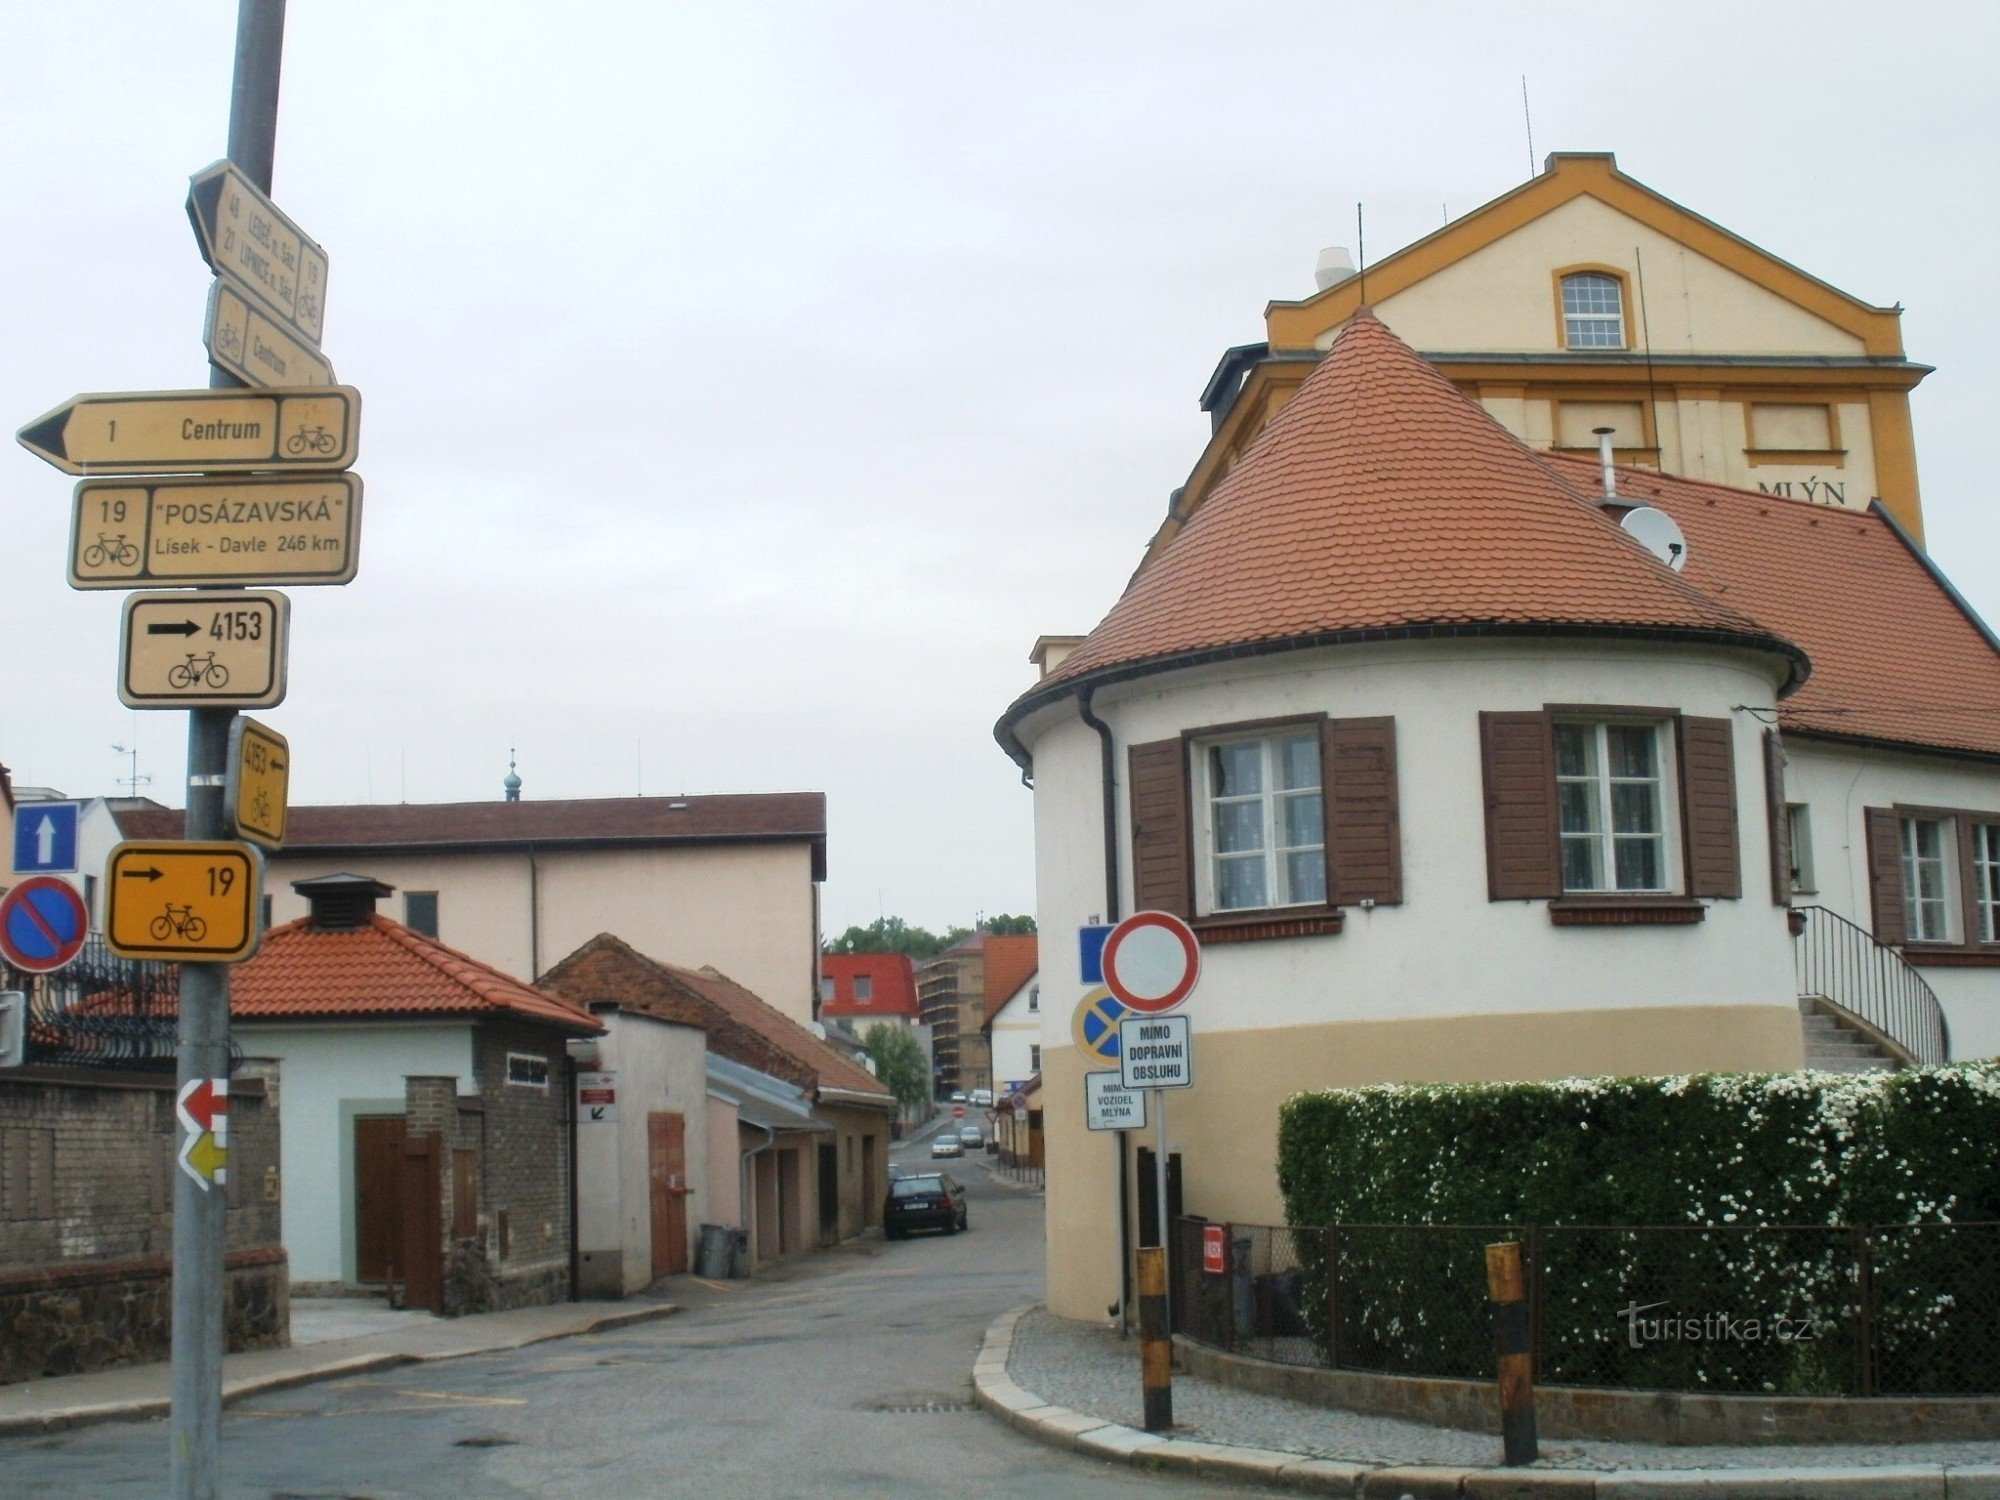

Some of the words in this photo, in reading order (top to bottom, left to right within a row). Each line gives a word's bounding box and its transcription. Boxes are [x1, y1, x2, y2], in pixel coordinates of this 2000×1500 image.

[309, 260, 319, 284] 19
[254, 335, 287, 377] Centrum
[107, 420, 116, 442] 1
[181, 418, 261, 441] Centrum
[100, 501, 127, 523] 19
[156, 495, 343, 525] "POSÁZAVSKÁ"
[155, 536, 200, 555] Lísek
[220, 536, 266, 553] Davle
[277, 535, 306, 552] 246
[312, 535, 340, 552] km
[209, 611, 262, 641] 4153
[243, 738, 267, 776] 4153
[207, 866, 235, 897] 19
[1139, 1025, 1170, 1040] MIMO
[1129, 1041, 1183, 1060] DOPRAVNÍ
[1133, 1064, 1181, 1080] OBSLUHU
[1102, 1084, 1122, 1093] MIM
[1097, 1096, 1133, 1105] VOZIDEL
